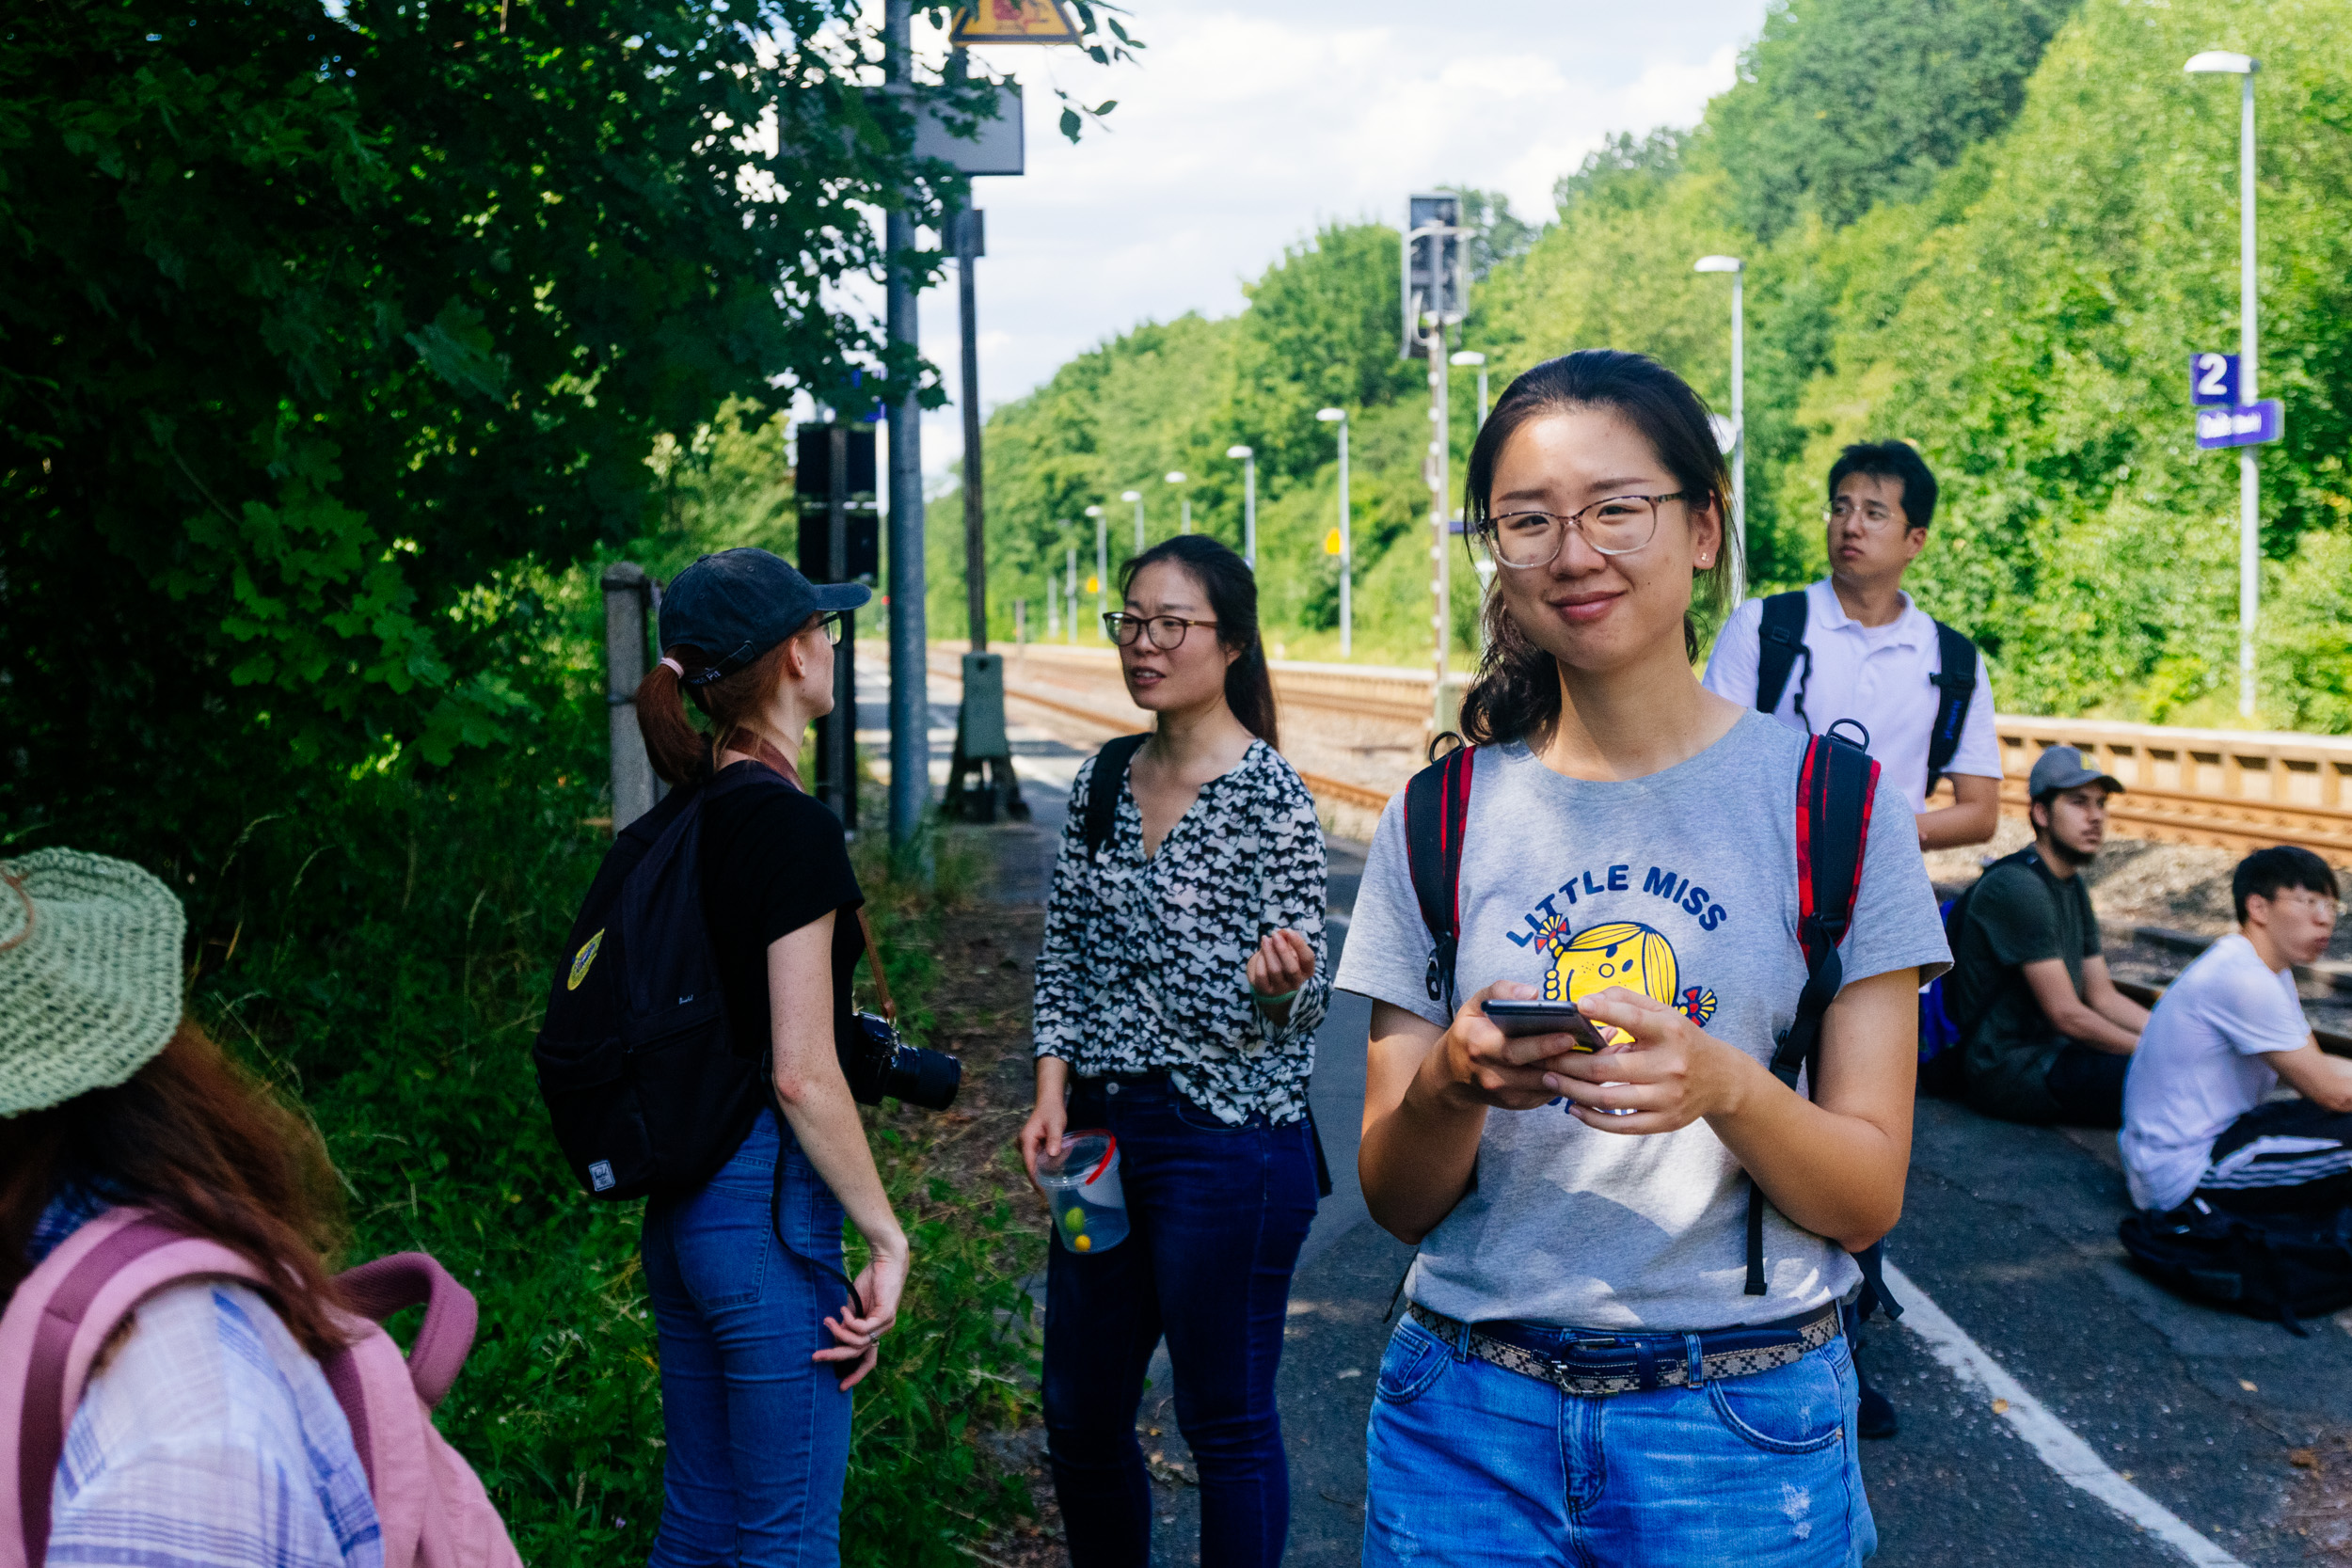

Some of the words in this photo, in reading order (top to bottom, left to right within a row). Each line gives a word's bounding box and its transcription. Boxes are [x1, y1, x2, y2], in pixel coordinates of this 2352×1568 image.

[2198, 353, 2228, 395] 2
[1505, 864, 1629, 948] LITTLE
[1643, 865, 1727, 931] MISS
